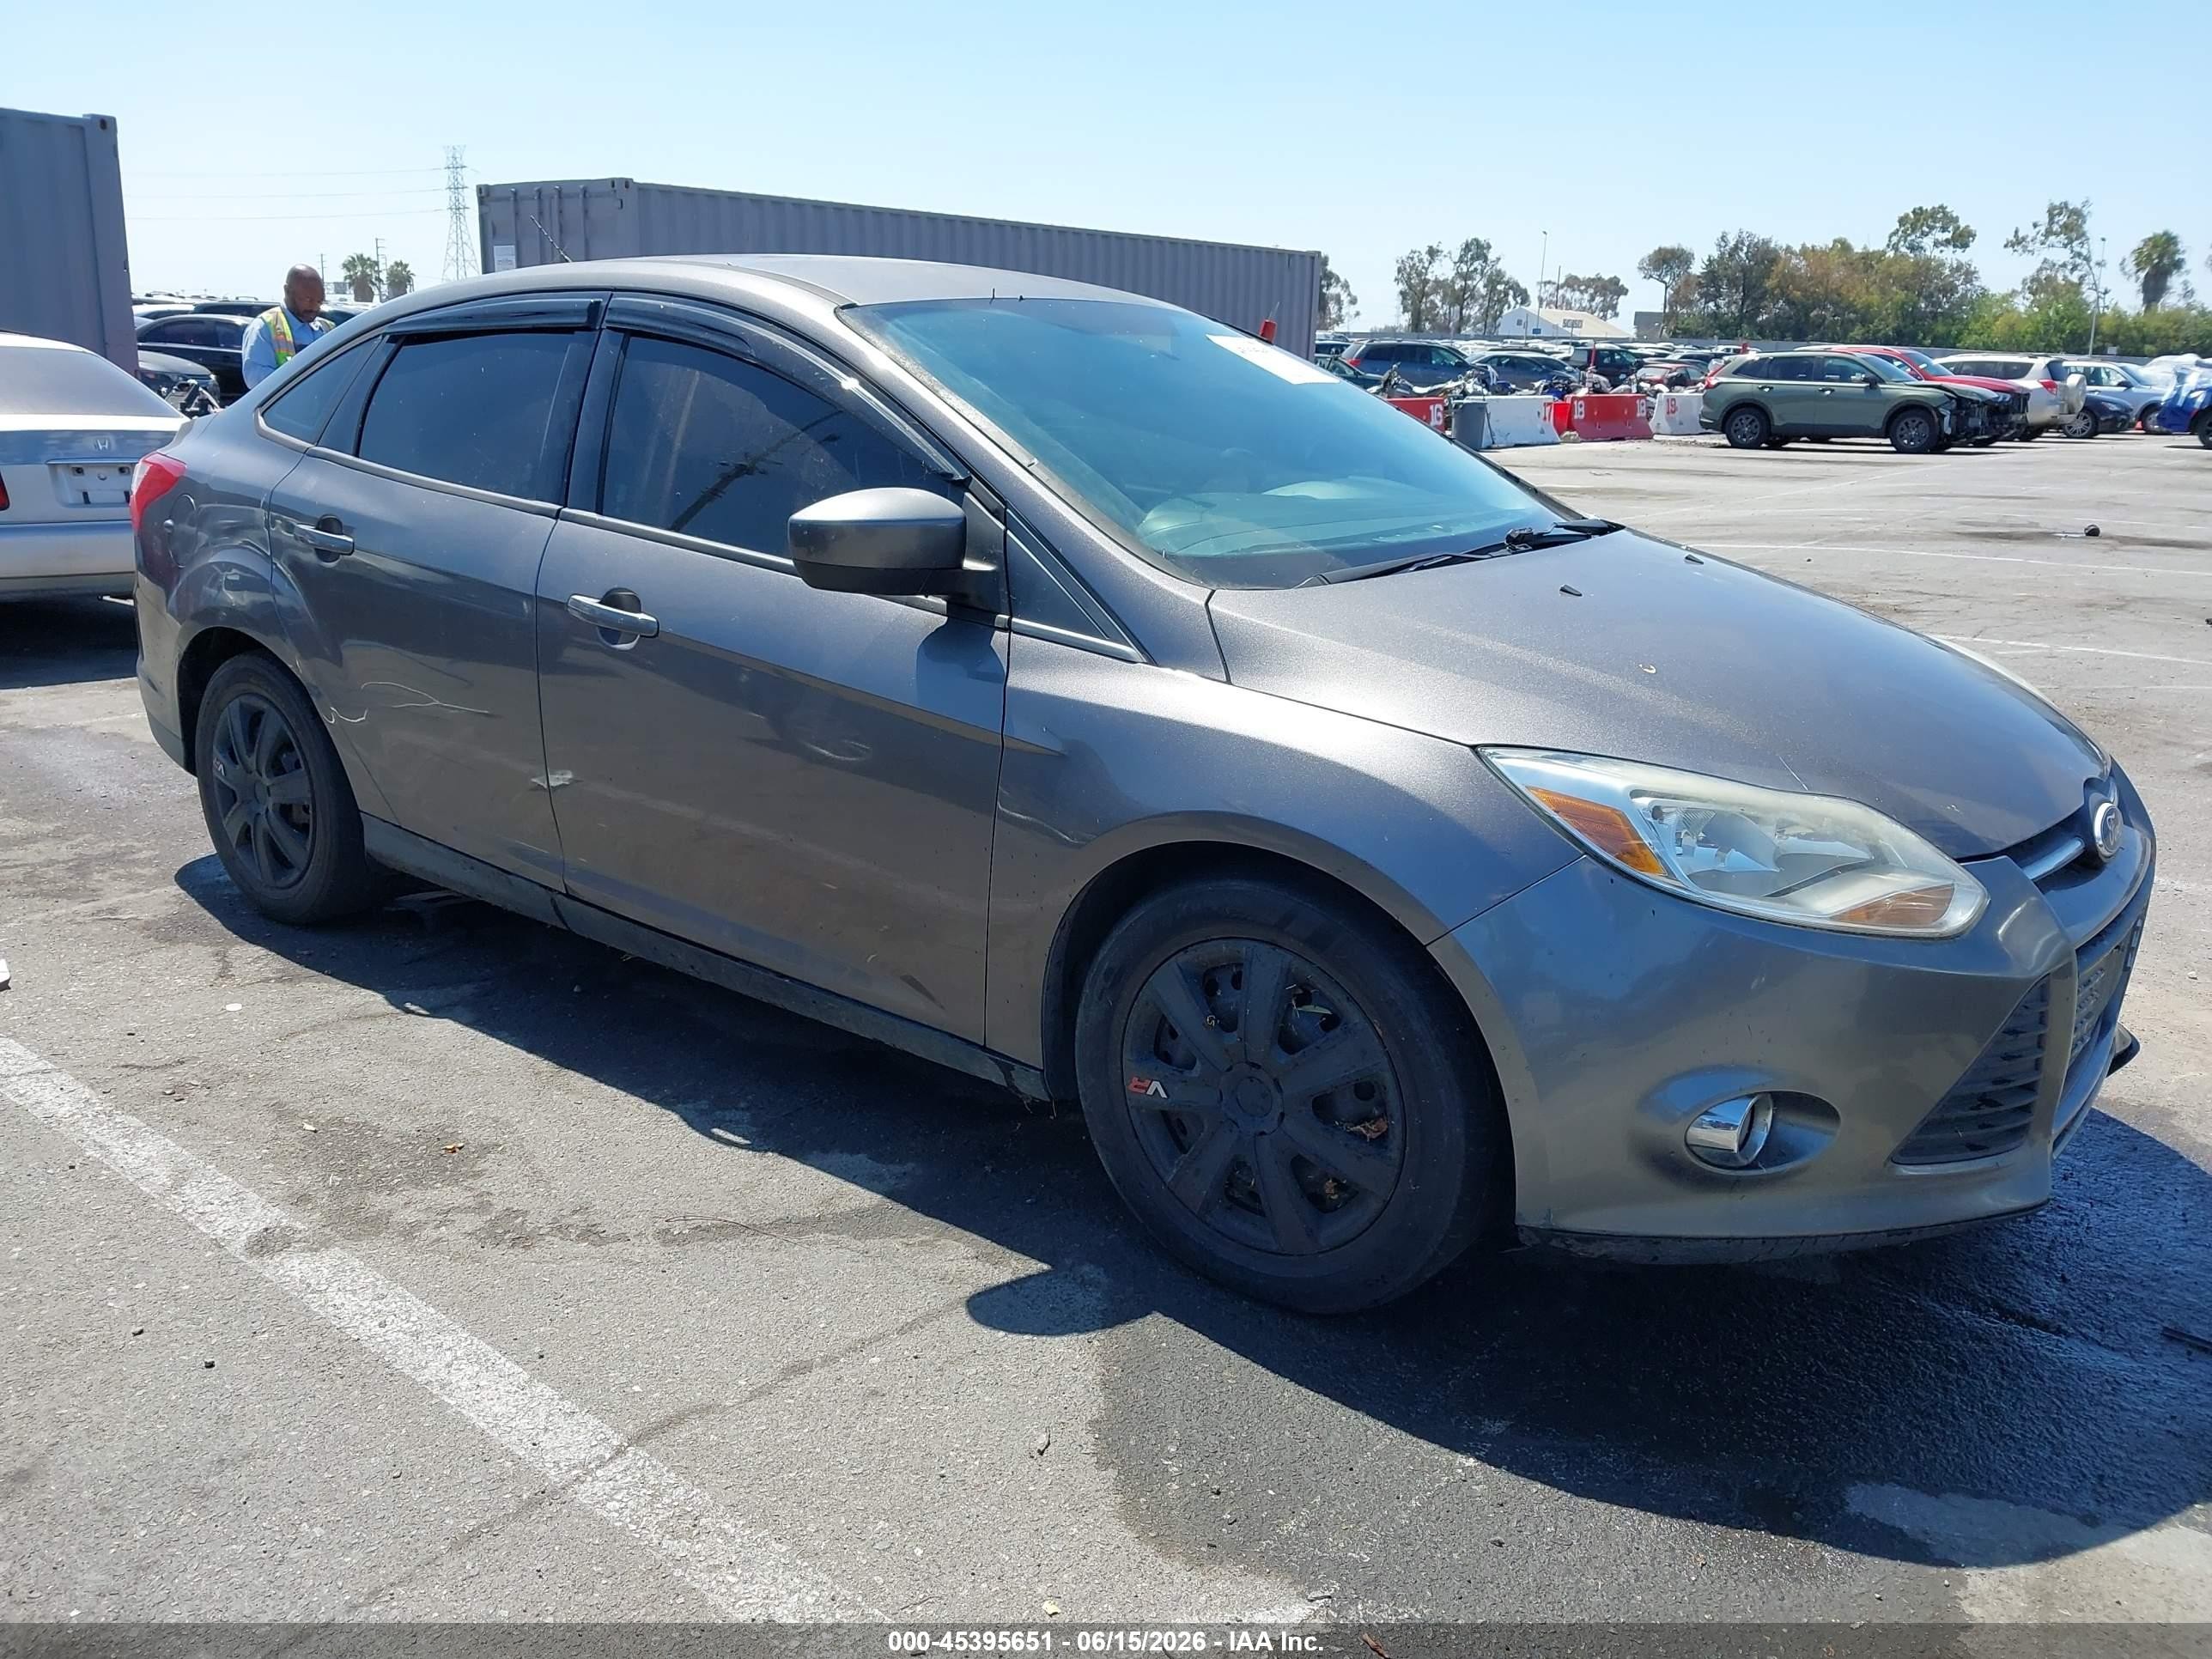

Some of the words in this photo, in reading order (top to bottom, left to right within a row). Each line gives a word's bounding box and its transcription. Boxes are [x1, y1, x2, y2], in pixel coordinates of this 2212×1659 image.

[1429, 404, 1443, 427] 16
[1573, 399, 1585, 420] 18
[1635, 398, 1647, 417] 18
[1666, 398, 1676, 415] 19
